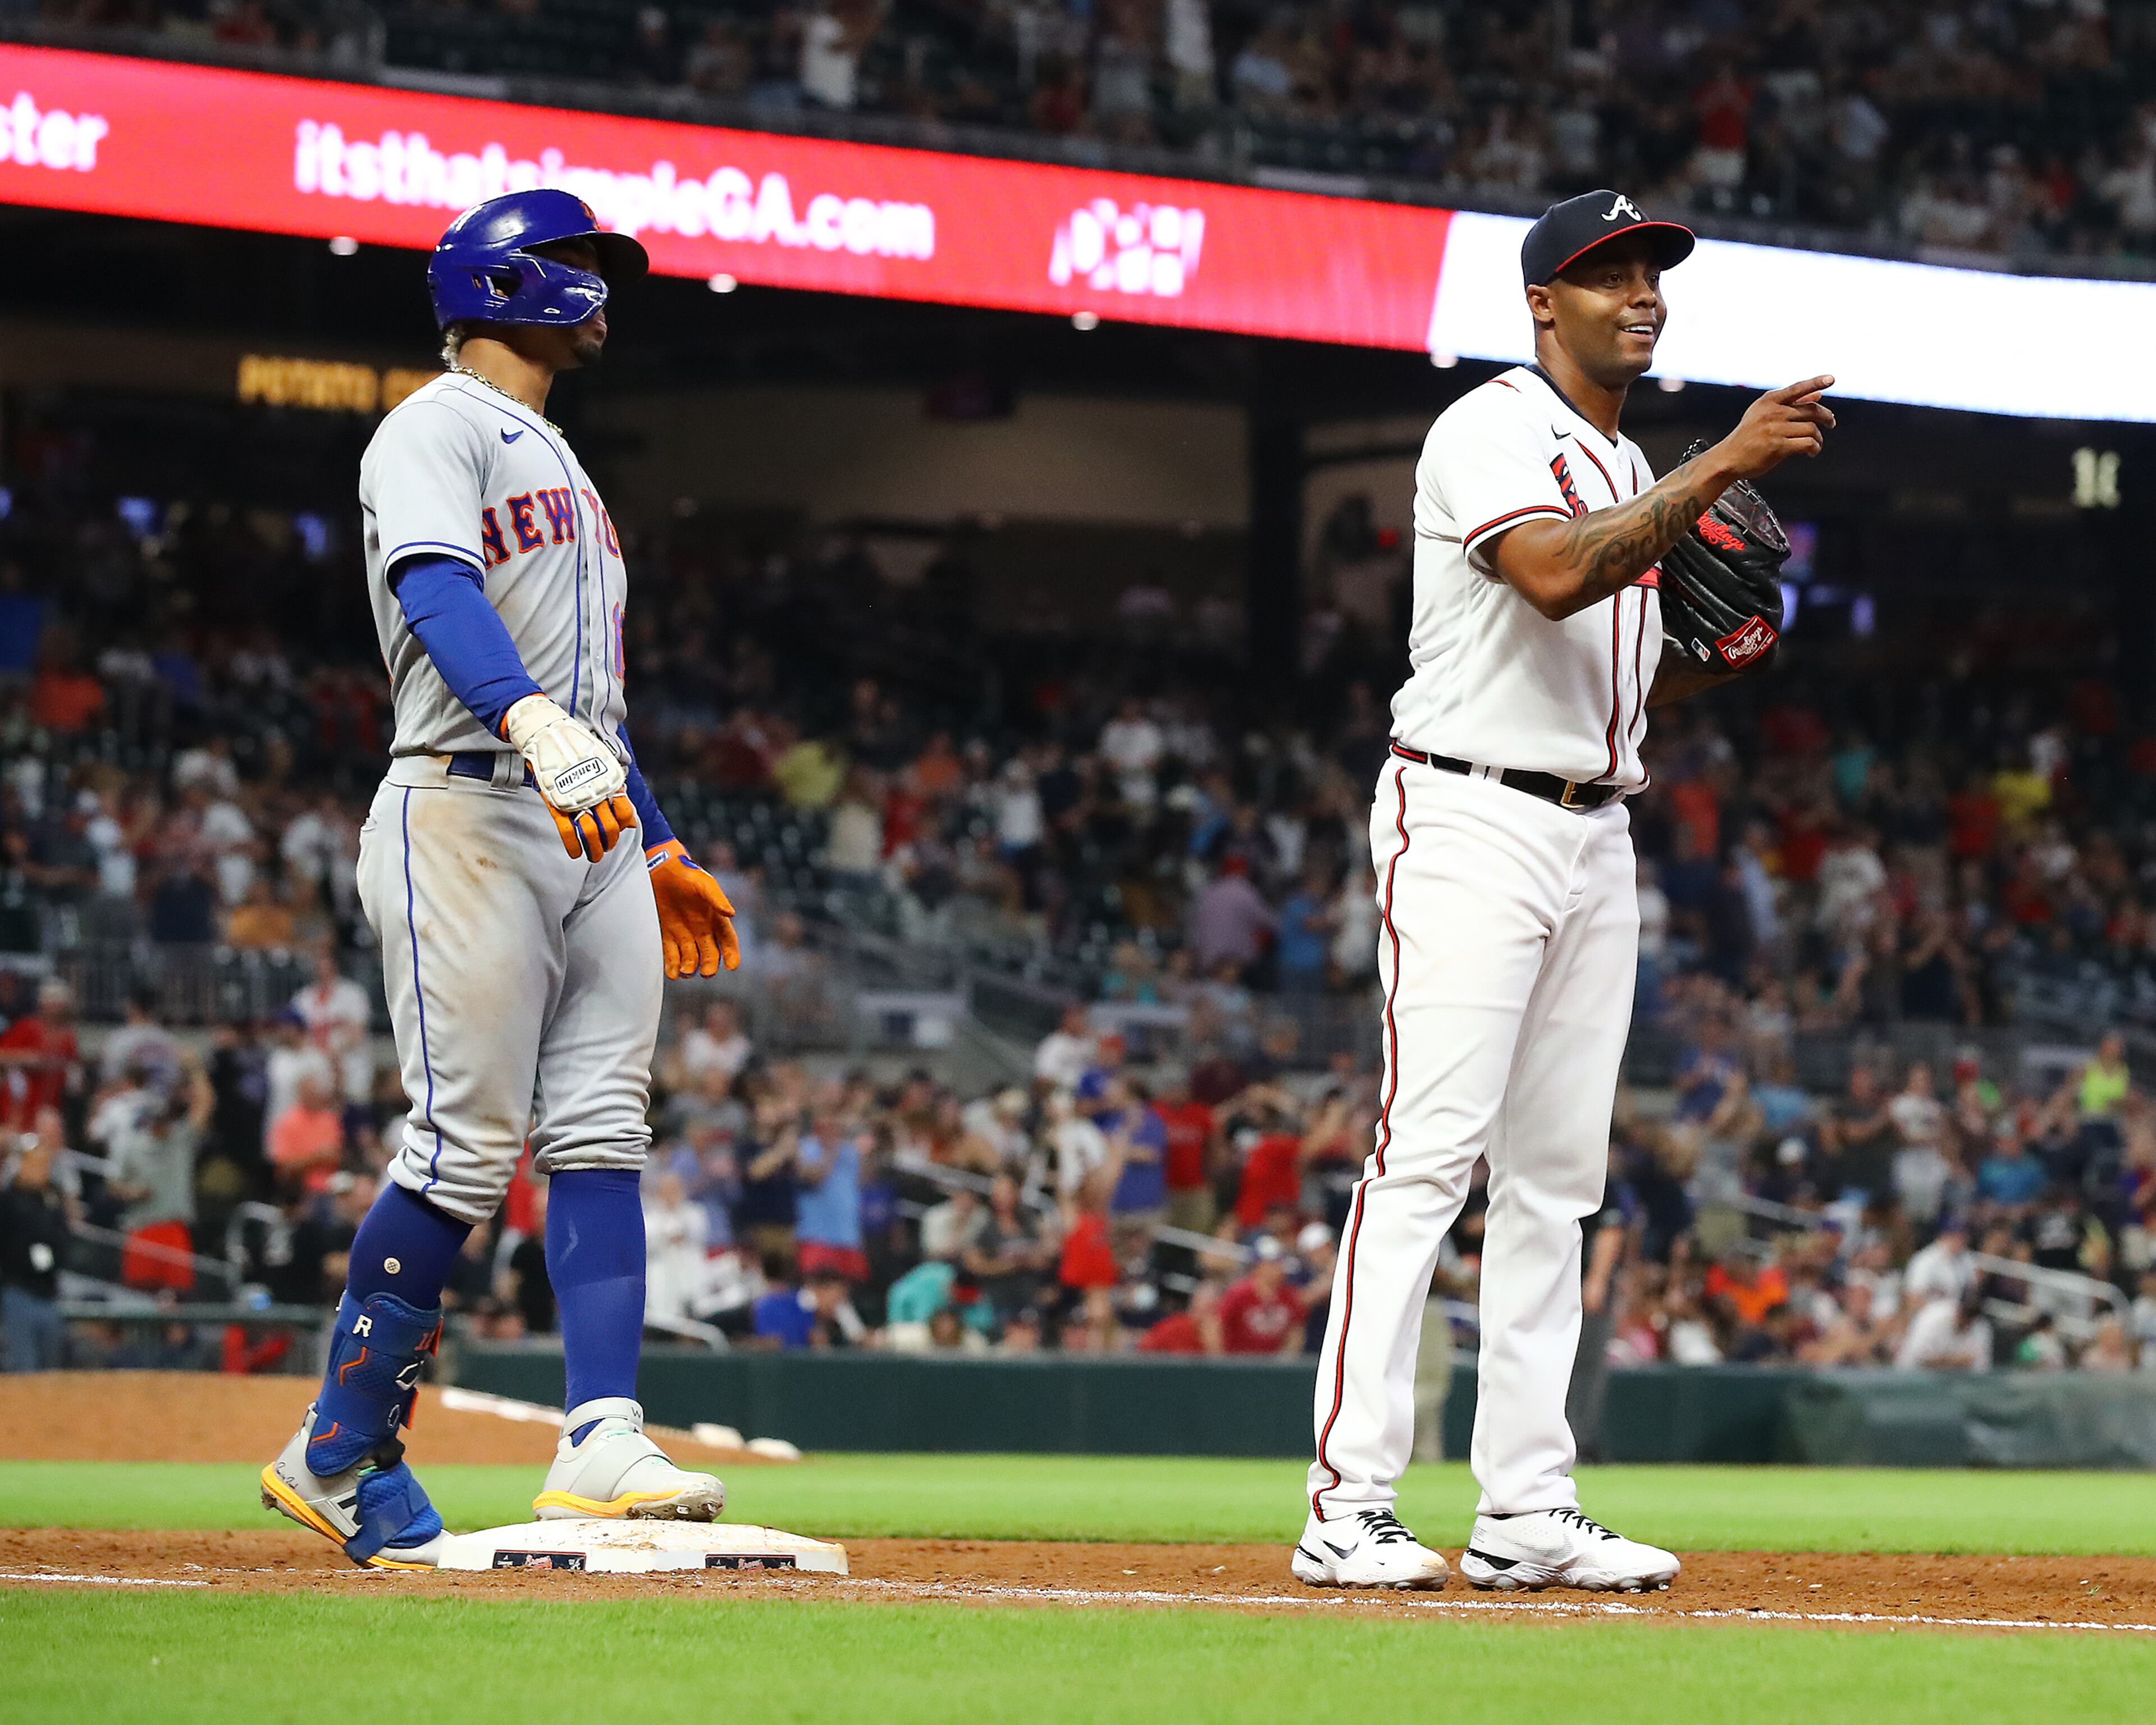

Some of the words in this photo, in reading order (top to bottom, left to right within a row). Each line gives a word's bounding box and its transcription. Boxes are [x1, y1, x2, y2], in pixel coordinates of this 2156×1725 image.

[1601, 195, 1642, 221] A
[482, 487, 575, 569] NEW
[1729, 626, 1762, 659] Rawlings
[352, 1314, 373, 1337] R
